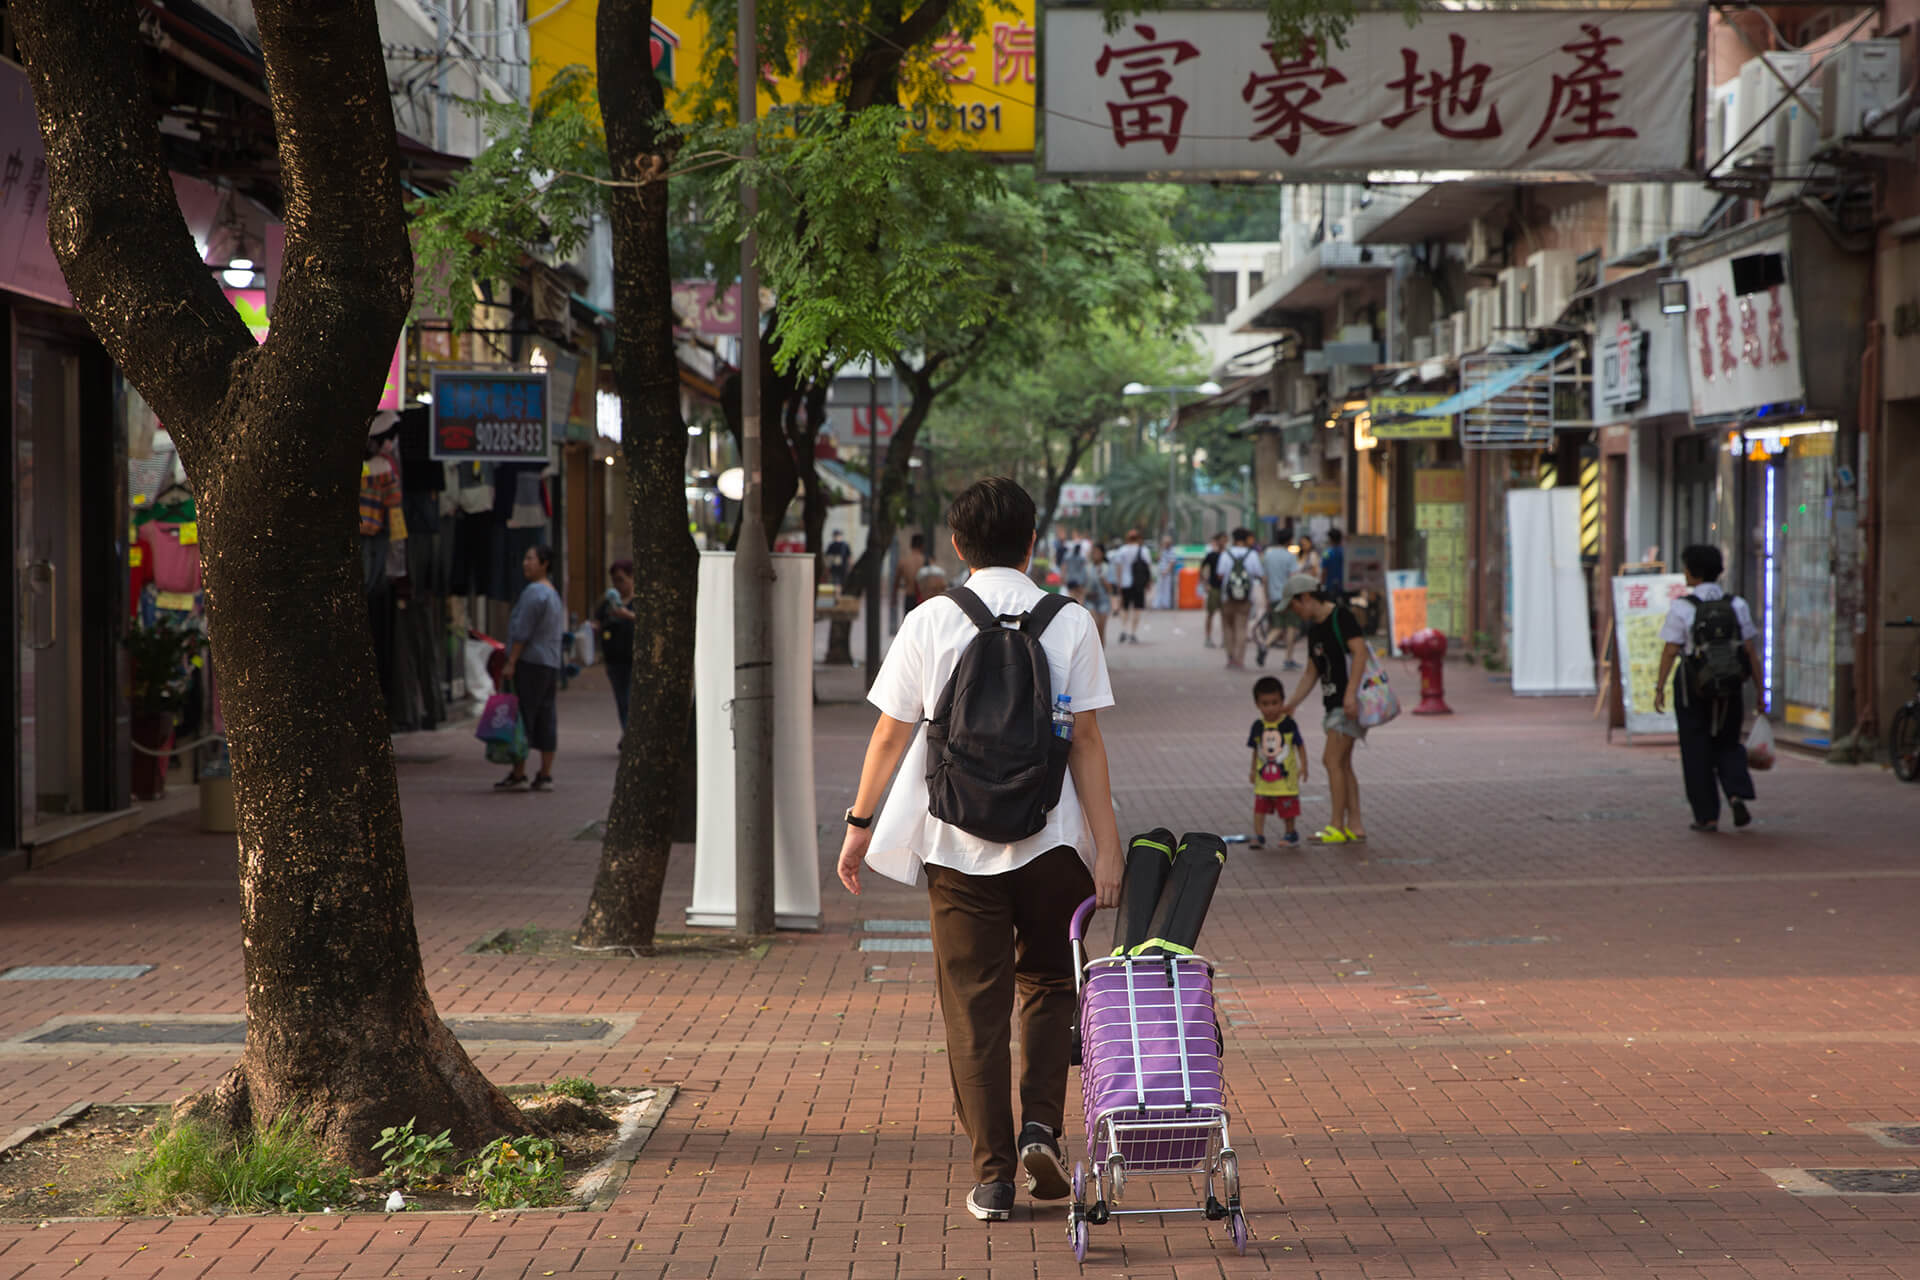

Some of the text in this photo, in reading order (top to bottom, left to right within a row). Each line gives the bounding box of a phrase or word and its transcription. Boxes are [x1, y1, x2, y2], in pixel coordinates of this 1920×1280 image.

[1095, 24, 1638, 156] 富豪地產
[475, 422, 543, 453] 90285433
